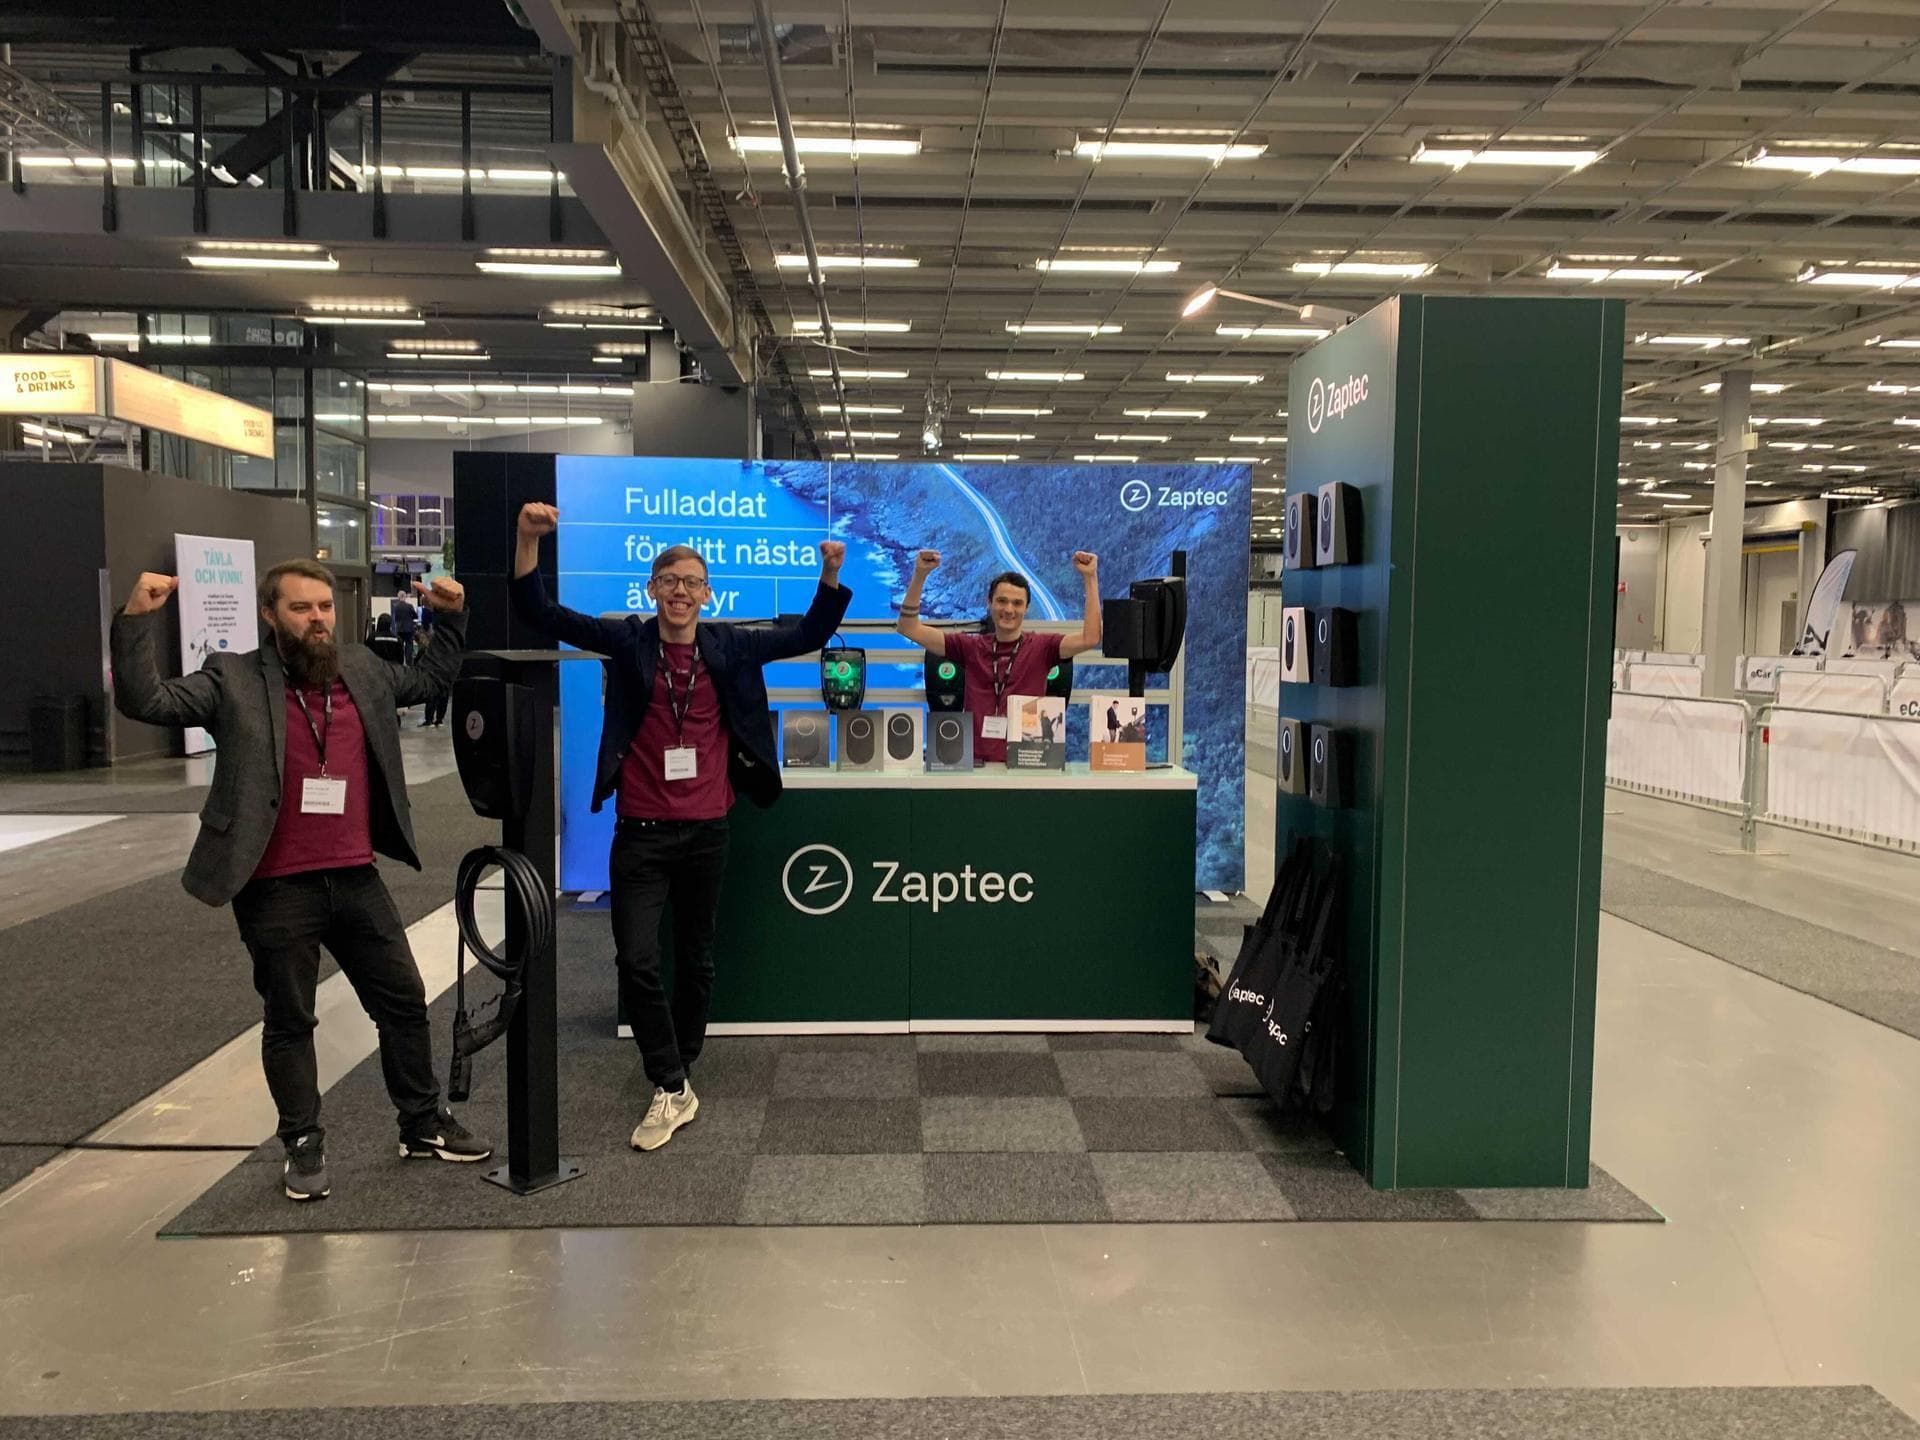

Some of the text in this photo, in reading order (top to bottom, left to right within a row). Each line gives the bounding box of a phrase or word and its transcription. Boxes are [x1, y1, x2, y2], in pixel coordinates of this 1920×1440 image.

[14, 371, 47, 382] FOOD
[16, 380, 76, 393] & DRINKS
[1327, 374, 1369, 420] Zaptec
[625, 487, 767, 518] Fulladdat
[1158, 486, 1229, 510] Zaptec
[624, 535, 668, 563] för
[735, 538, 818, 566] nästa
[194, 567, 216, 584] OCH
[626, 582, 740, 617] ävyr
[872, 861, 1034, 913] Zaptec
